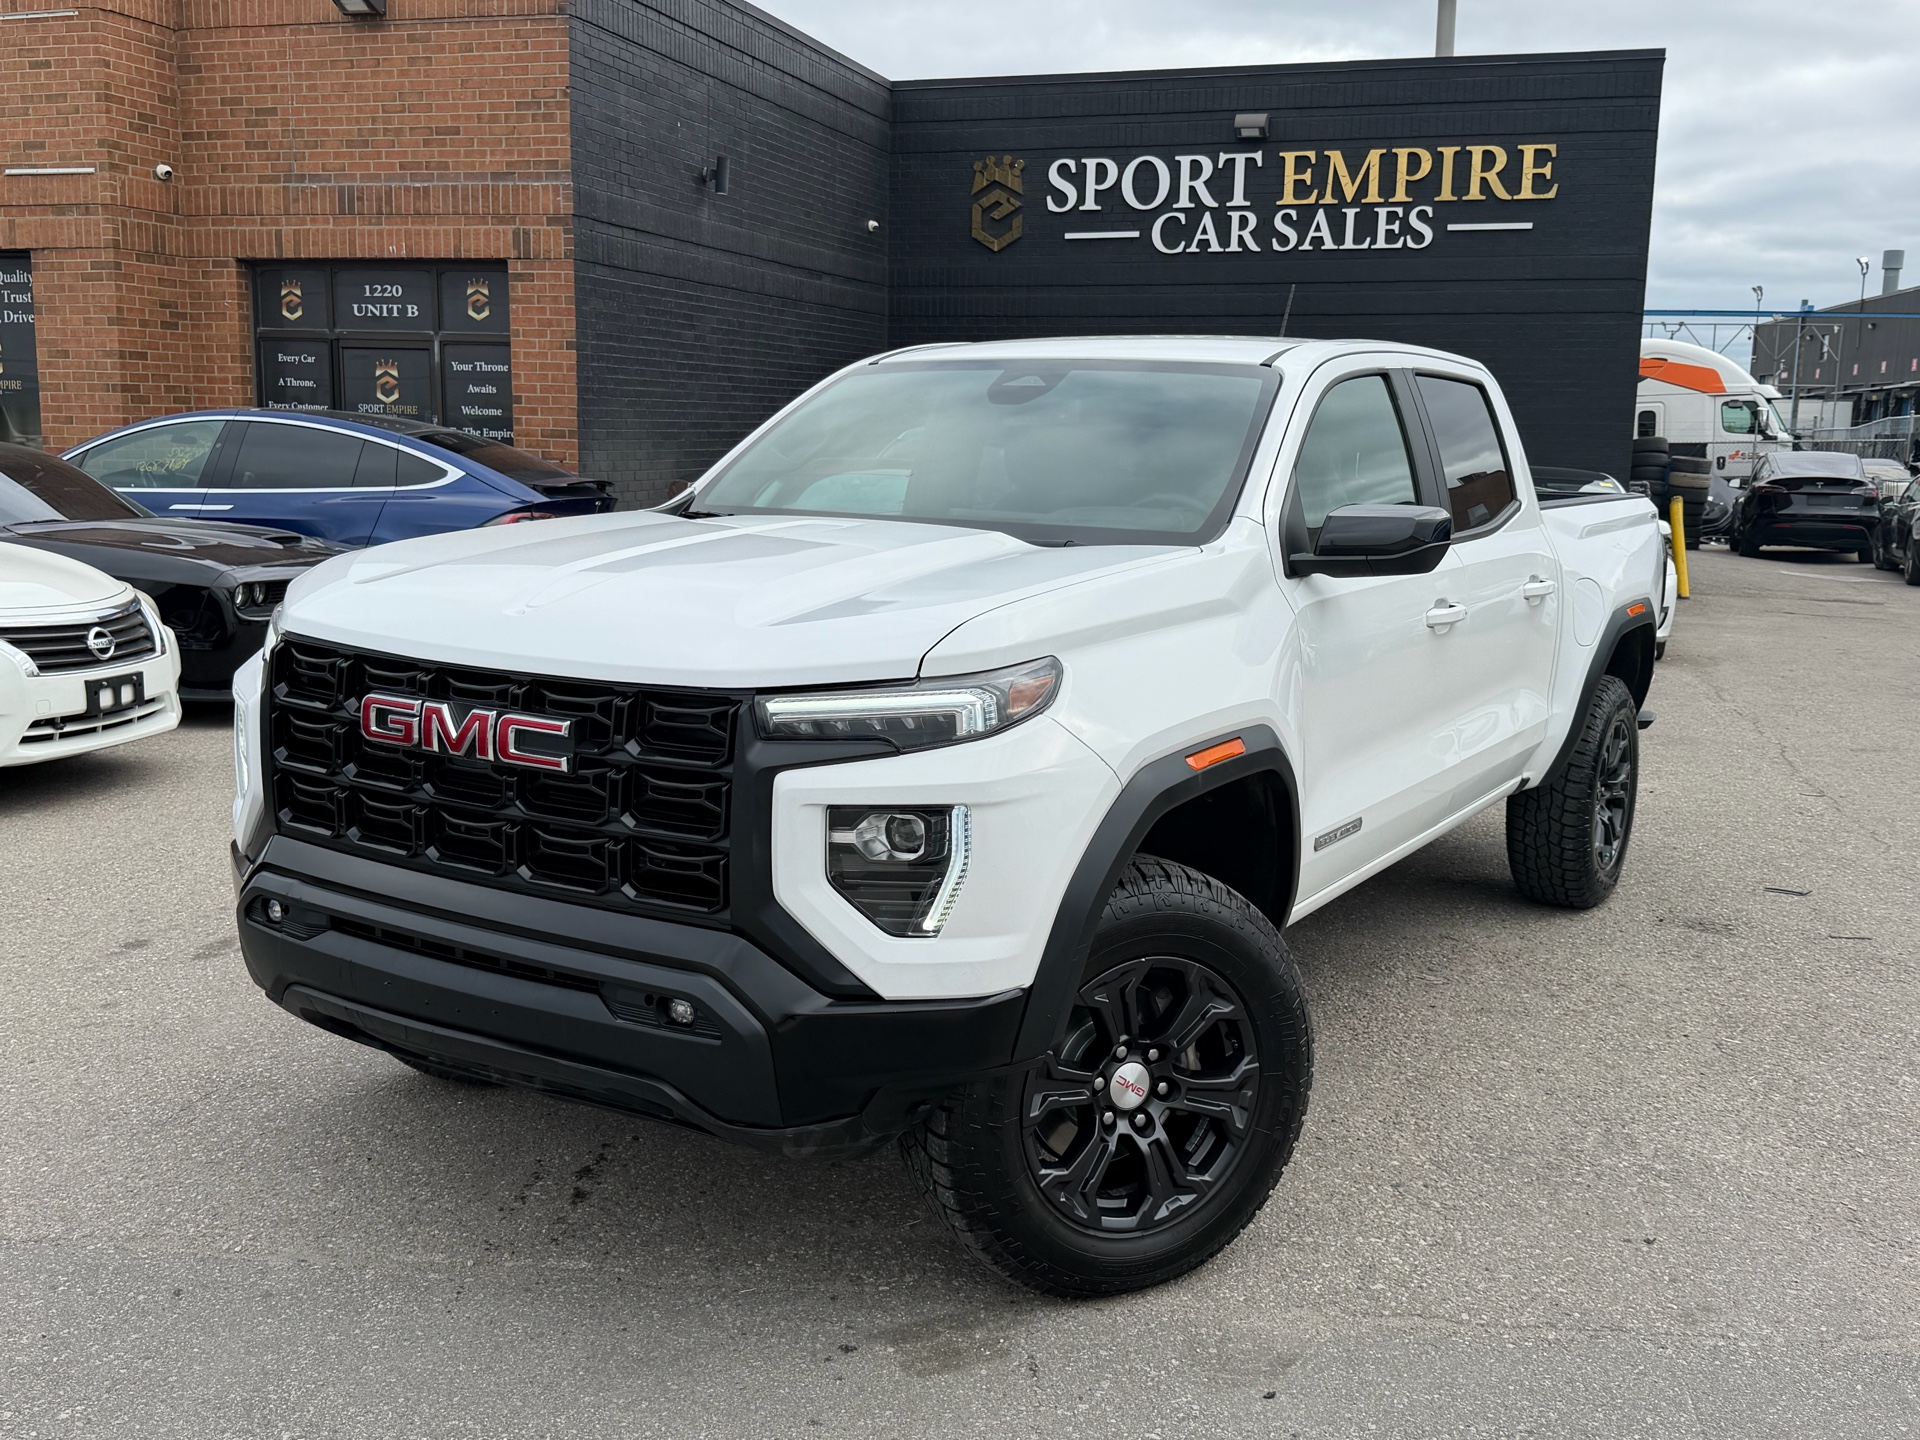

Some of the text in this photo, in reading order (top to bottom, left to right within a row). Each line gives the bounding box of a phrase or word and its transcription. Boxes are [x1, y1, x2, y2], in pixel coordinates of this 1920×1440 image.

[1046, 144, 1559, 212] SPORT EMPIRE
[1151, 206, 1434, 254] CAR SALES
[1, 290, 32, 303] Trust
[364, 284, 403, 297] 1220
[4, 310, 35, 323] Drive
[352, 304, 419, 317] UNIT B
[278, 353, 316, 364] Every Car
[451, 362, 509, 372] Your Throne
[286, 380, 317, 388] Throne,
[467, 384, 497, 394] Awaits
[358, 403, 418, 415] SPORT EMPIRE
[461, 406, 503, 416] Welcome
[361, 693, 571, 773] GMC
[1267, 989, 1297, 1158] MIRAGE
[1115, 1074, 1146, 1098] GMC
